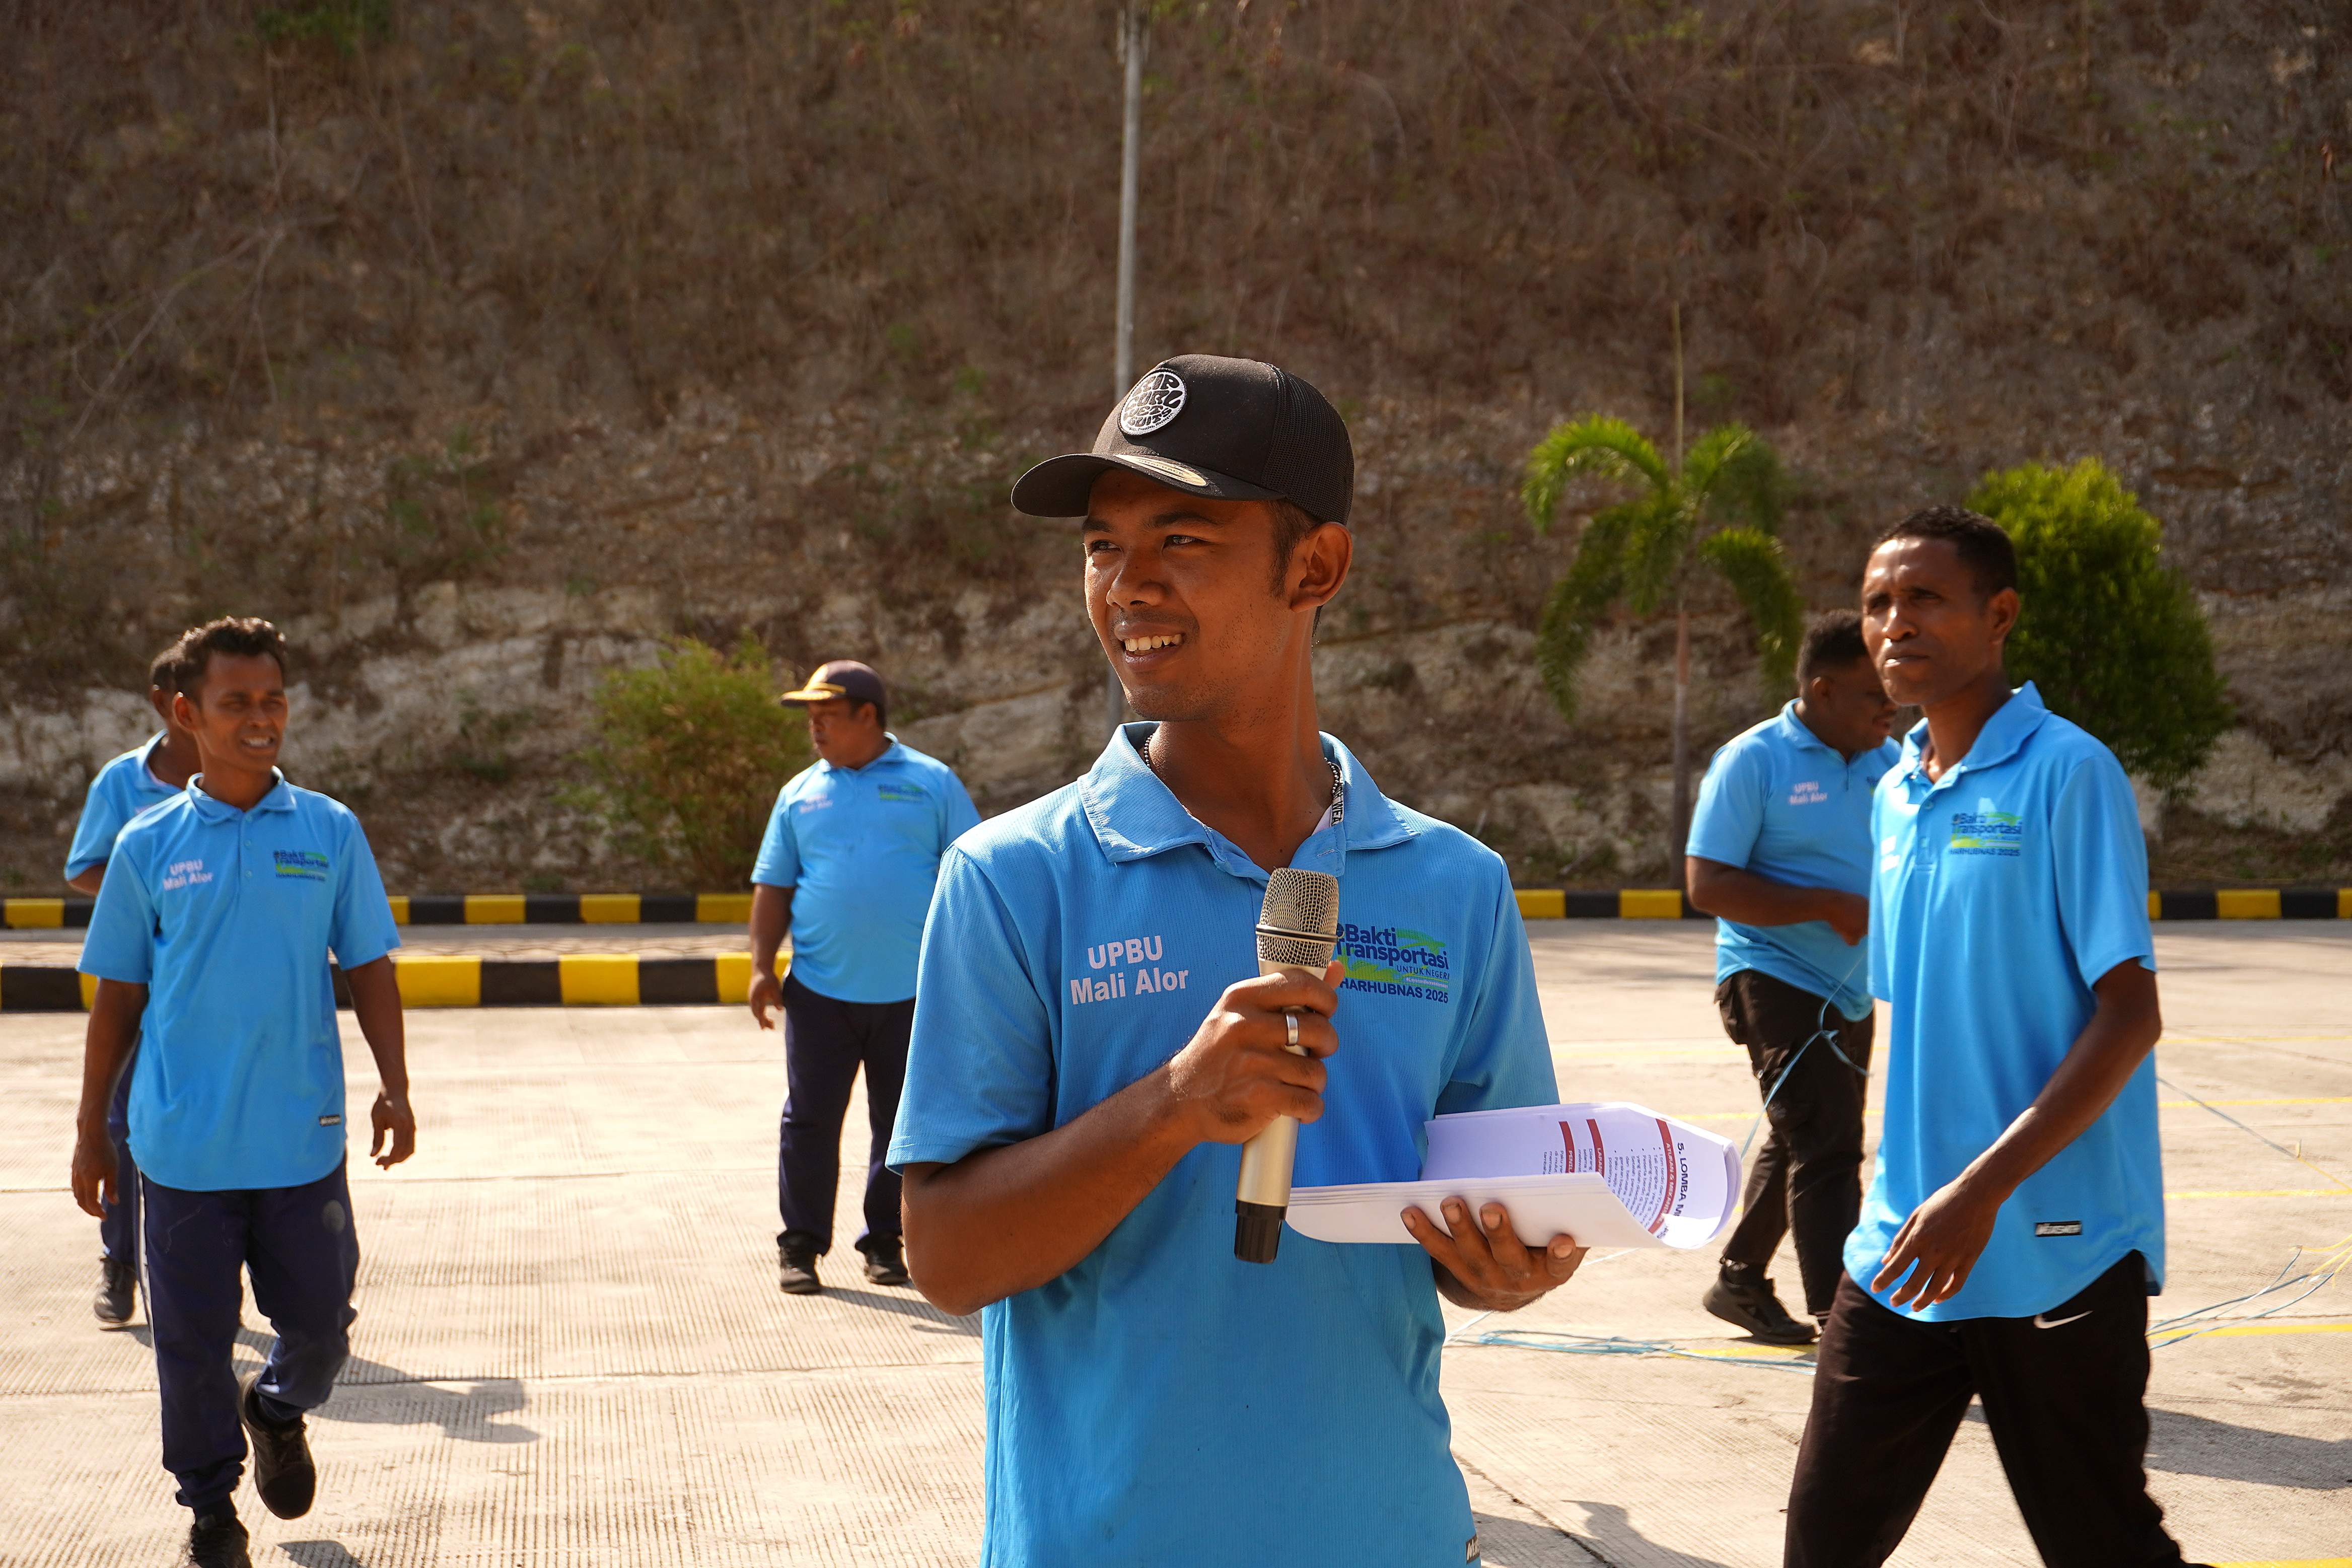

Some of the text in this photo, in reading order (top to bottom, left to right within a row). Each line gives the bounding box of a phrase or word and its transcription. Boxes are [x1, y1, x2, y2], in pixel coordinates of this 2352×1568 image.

[169, 859, 203, 875] UPBU
[1088, 935, 1165, 970] UPBU
[1336, 938, 1449, 970] Transportasi
[1396, 965, 1450, 980] UNTUK NEGERI
[1070, 967, 1189, 1005] Mali Alor
[1426, 988, 1449, 1004] 2025
[1678, 1143, 1684, 1154] 5.
[1679, 1158, 1688, 1201] LOMBA
